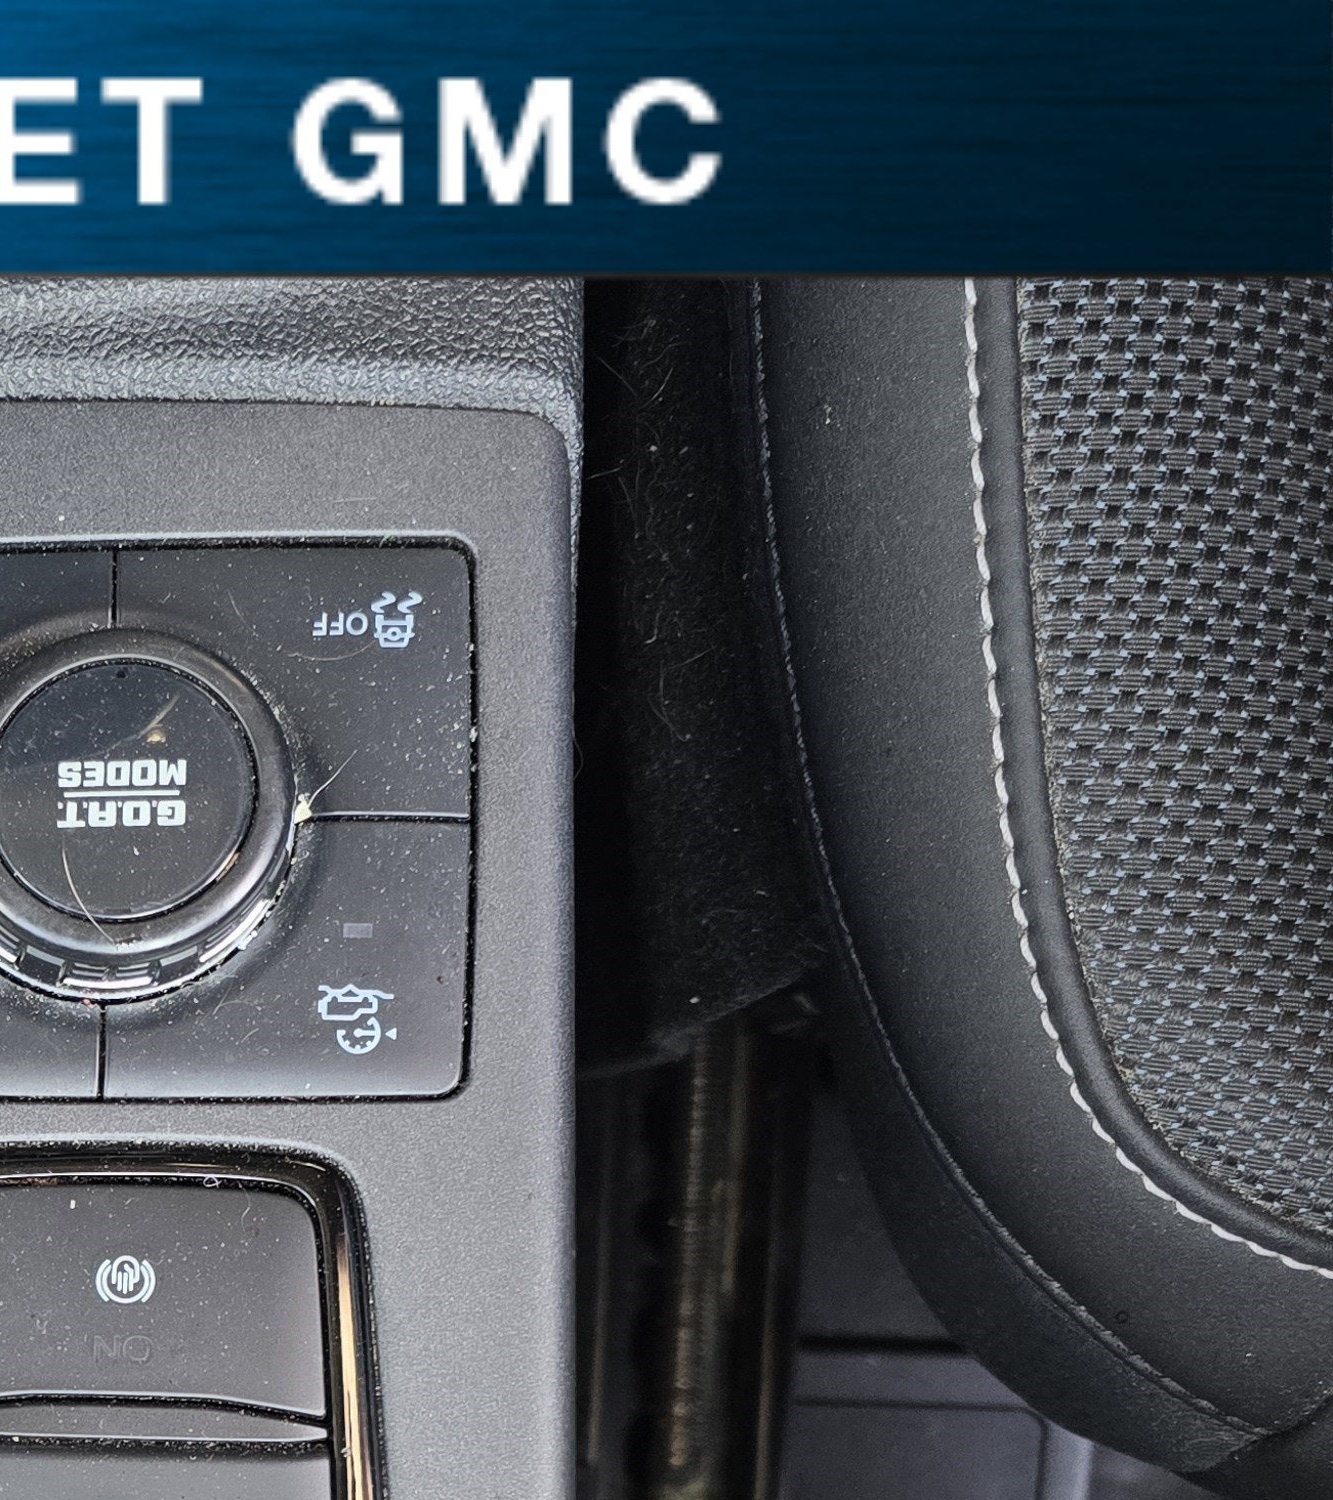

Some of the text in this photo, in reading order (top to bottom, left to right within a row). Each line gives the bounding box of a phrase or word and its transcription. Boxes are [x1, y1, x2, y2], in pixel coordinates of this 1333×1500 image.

[311, 606, 369, 638] OFF
[56, 758, 188, 788] MODES
[56, 799, 188, 829] G.O.A.T.
